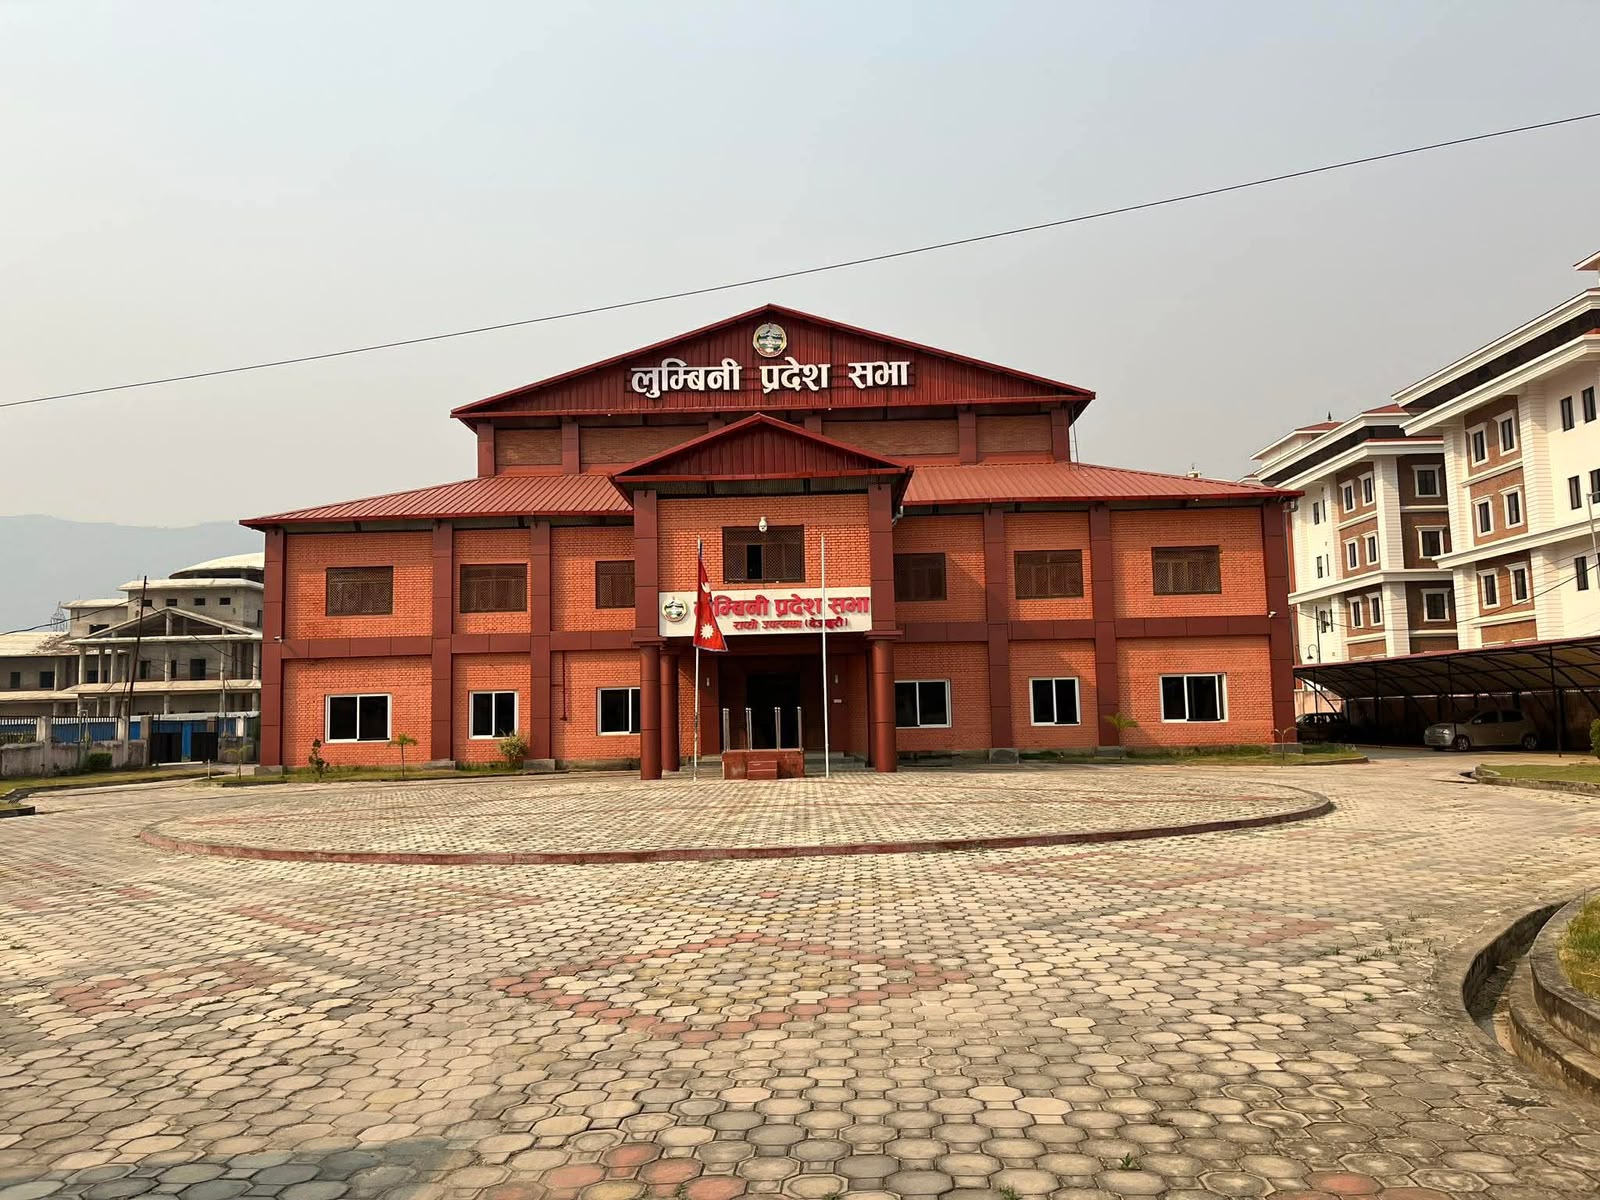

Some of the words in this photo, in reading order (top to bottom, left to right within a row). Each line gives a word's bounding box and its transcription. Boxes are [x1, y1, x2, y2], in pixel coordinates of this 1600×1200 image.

[631, 358, 742, 398] लुम्बिनी
[760, 356, 830, 394] प्रदेश
[848, 361, 910, 389] सभा
[694, 594, 770, 617] म्बिनी
[774, 593, 821, 617] प्रदेश
[828, 597, 870, 616] सभा
